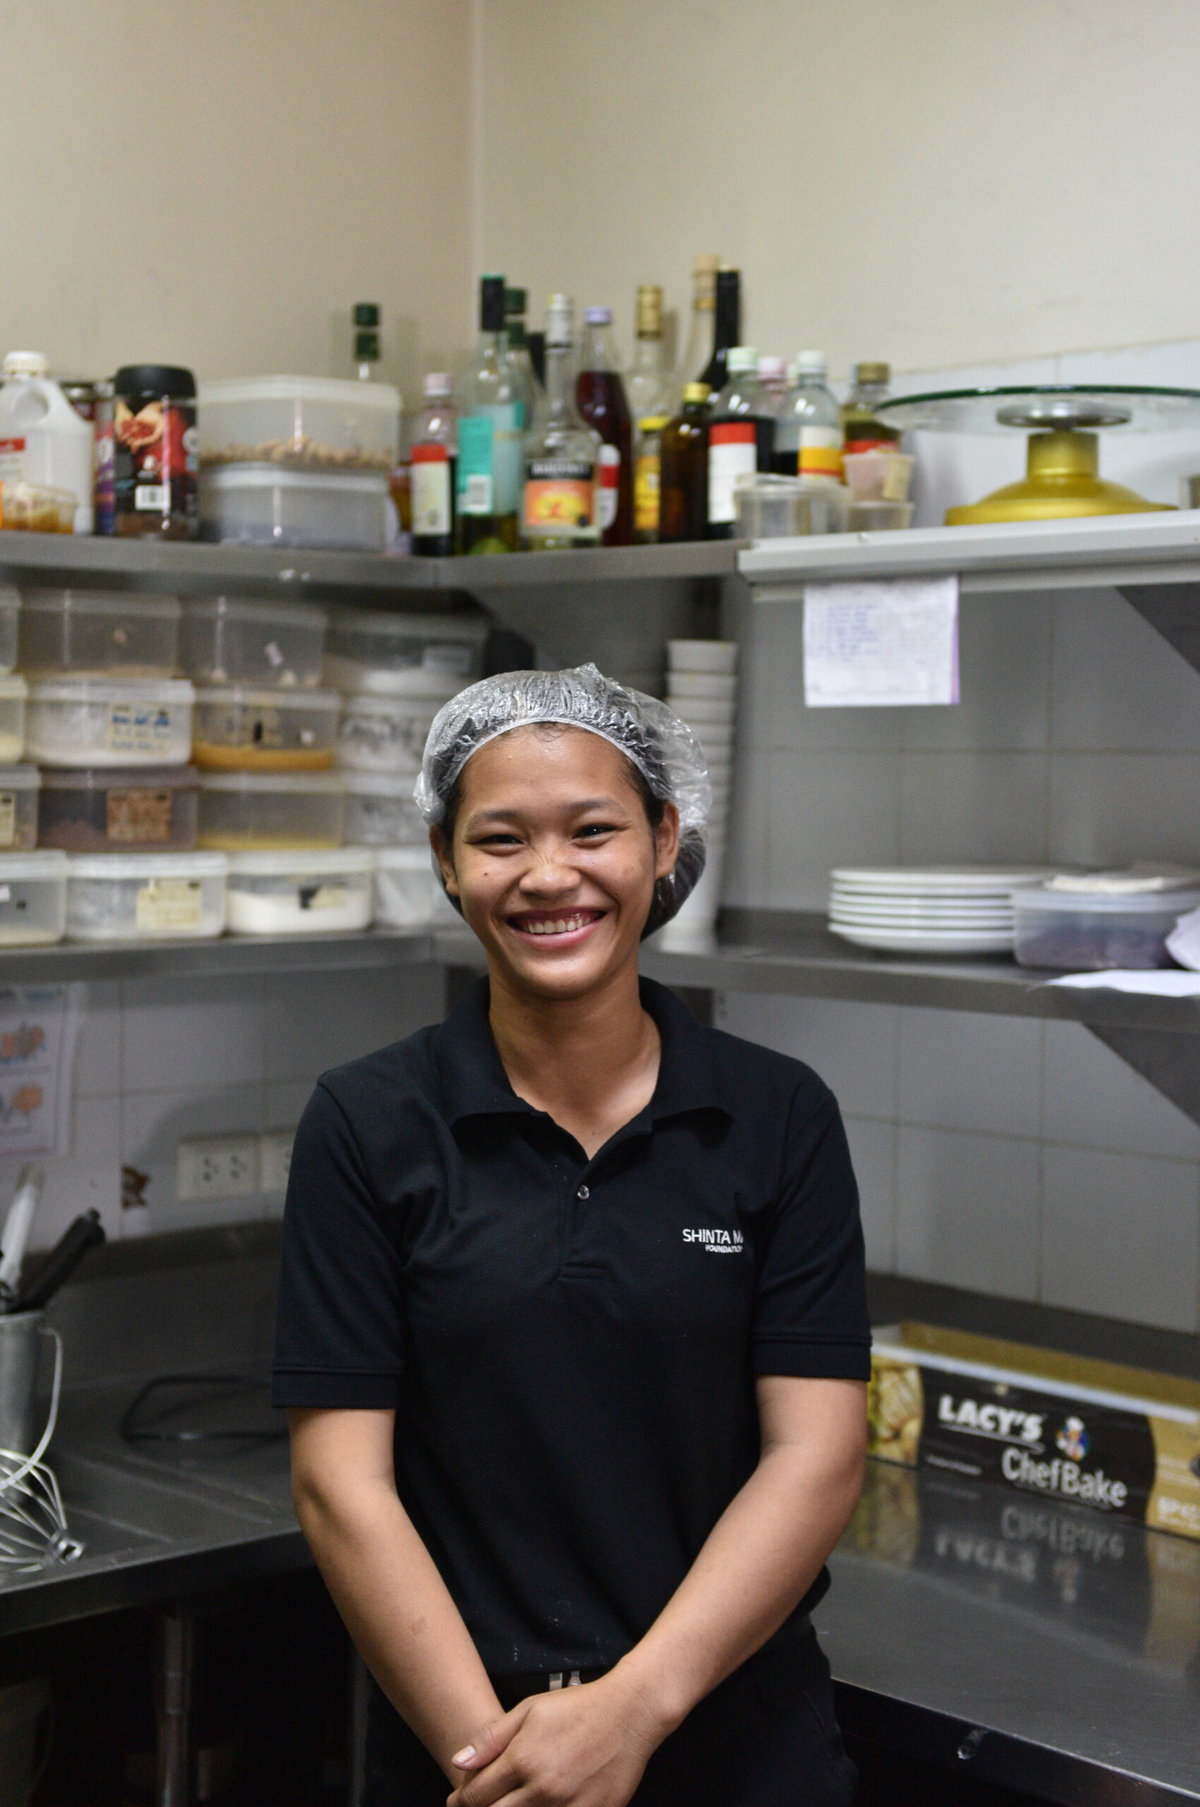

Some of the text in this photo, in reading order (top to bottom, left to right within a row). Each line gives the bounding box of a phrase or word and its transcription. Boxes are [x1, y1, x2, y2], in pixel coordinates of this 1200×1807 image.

[682, 1228, 731, 1244] SHINTA
[938, 1395, 1043, 1441] LACY'S
[1002, 1447, 1128, 1507] ChefBake
